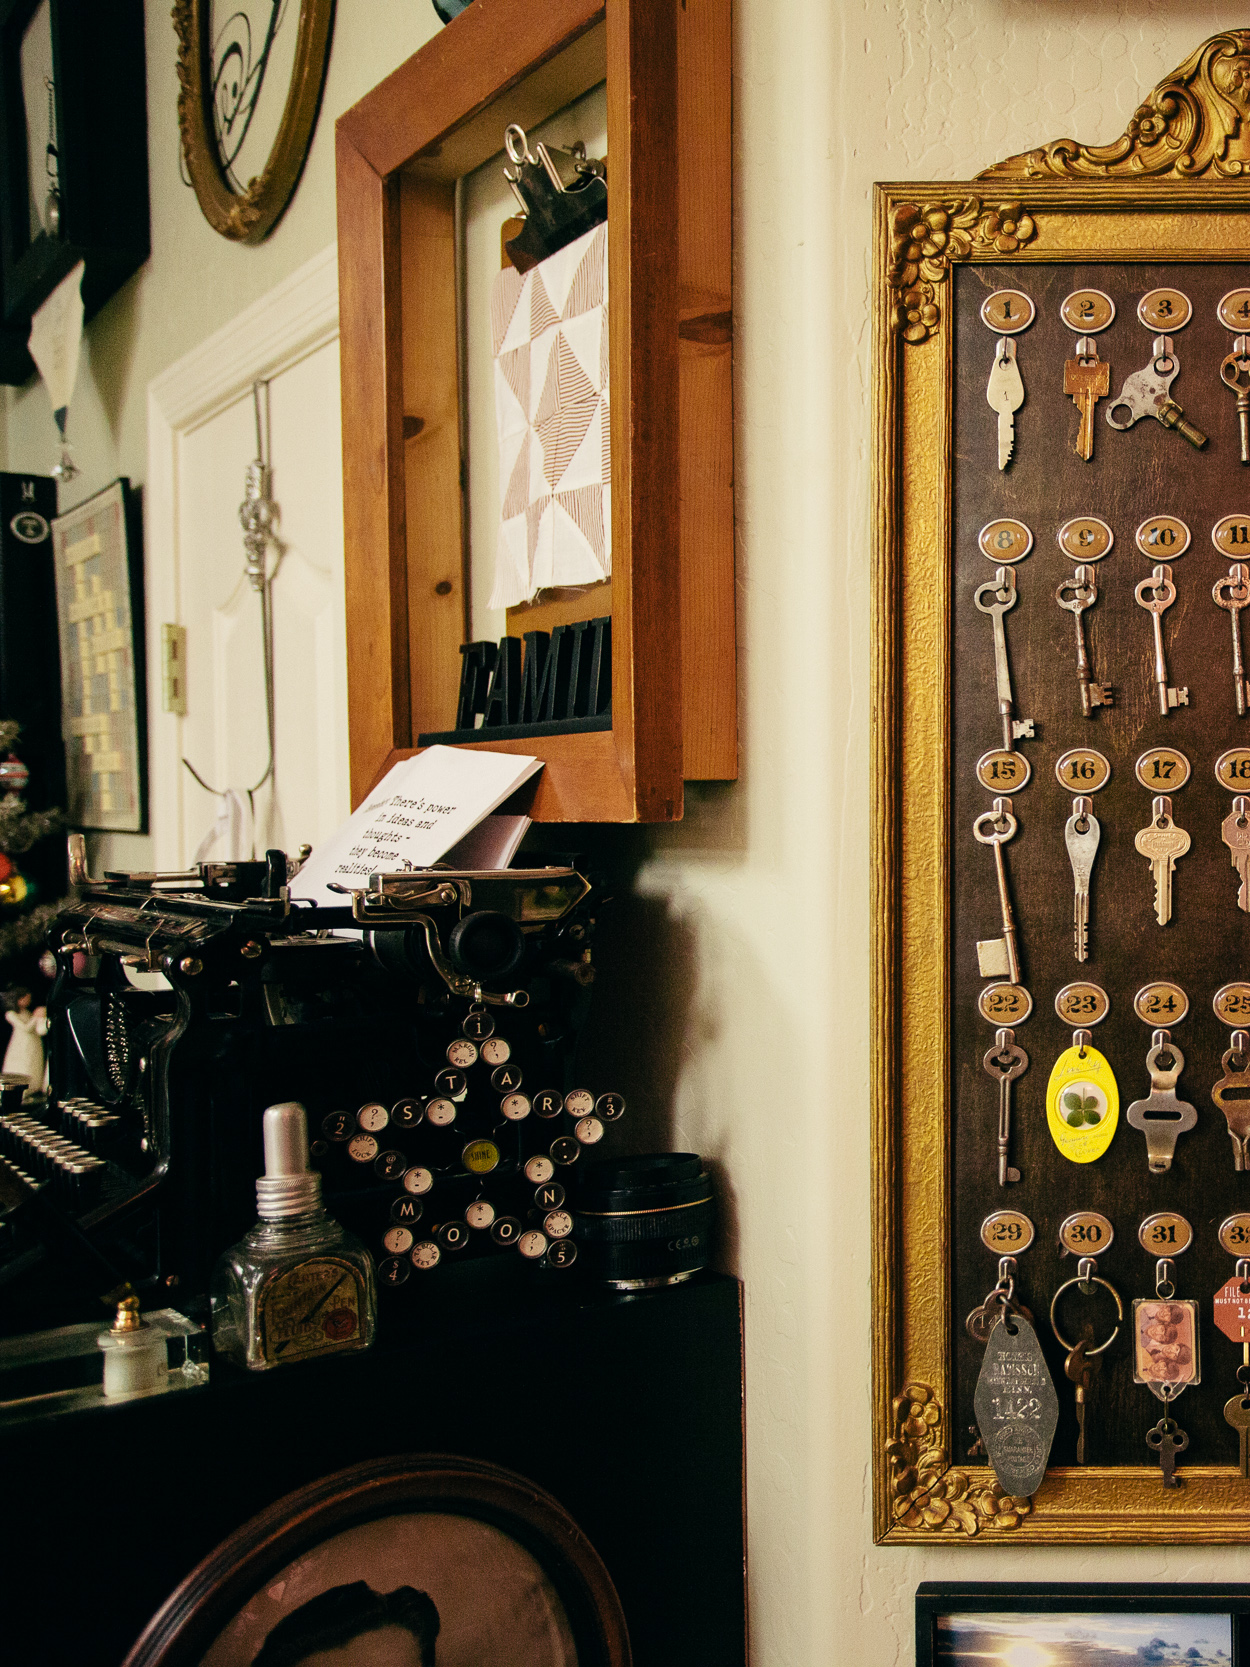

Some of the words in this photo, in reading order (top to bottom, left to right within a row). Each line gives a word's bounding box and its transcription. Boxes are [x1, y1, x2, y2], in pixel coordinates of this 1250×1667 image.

[1004, 301, 1012, 319] 1
[1080, 300, 1095, 317] 2
[1158, 300, 1172, 317] 3
[998, 530, 1013, 548] 8
[1079, 529, 1092, 546] 9
[1150, 527, 1175, 546] 10
[1230, 526, 1250, 544] 11
[991, 761, 1015, 779] 15
[1071, 761, 1095, 779] 16
[1152, 760, 1176, 778] 17
[390, 796, 425, 810] There's
[424, 802, 456, 814] power
[375, 812, 387, 822] in
[387, 813, 415, 827] ideas
[415, 820, 437, 829] and
[363, 828, 402, 842] thoughts
[349, 845, 368, 858] they
[368, 847, 399, 860] become
[989, 995, 1019, 1012] 22
[1067, 996, 1097, 1013] 23
[1146, 995, 1177, 1013] 24
[452, 1043, 474, 1058] MARGIN
[445, 1075, 457, 1090] T
[501, 1071, 513, 1086] A
[542, 1097, 553, 1111] R
[570, 1092, 589, 1102] SHIFT
[403, 1105, 412, 1120] S
[572, 1106, 586, 1114] KEY
[606, 1104, 615, 1116] 3
[335, 1122, 344, 1135] 2
[354, 1135, 375, 1147] SHIFT
[351, 1148, 372, 1158] LOCK
[470, 1149, 491, 1162] SHINE
[543, 1189, 555, 1204] N
[400, 1202, 414, 1216] M
[549, 1213, 568, 1222] BACK
[447, 1228, 460, 1242] O
[500, 1224, 512, 1237] O
[547, 1223, 570, 1235] SPACER
[993, 1223, 1022, 1240] 29
[1071, 1225, 1101, 1242] 30
[1152, 1225, 1177, 1243] 31
[415, 1244, 436, 1261] TABULAR
[557, 1251, 565, 1263] 5
[415, 1258, 430, 1266] KEY
[389, 1269, 397, 1281] 4
[1224, 1286, 1240, 1297] FILE
[330, 1295, 356, 1308] PEN
